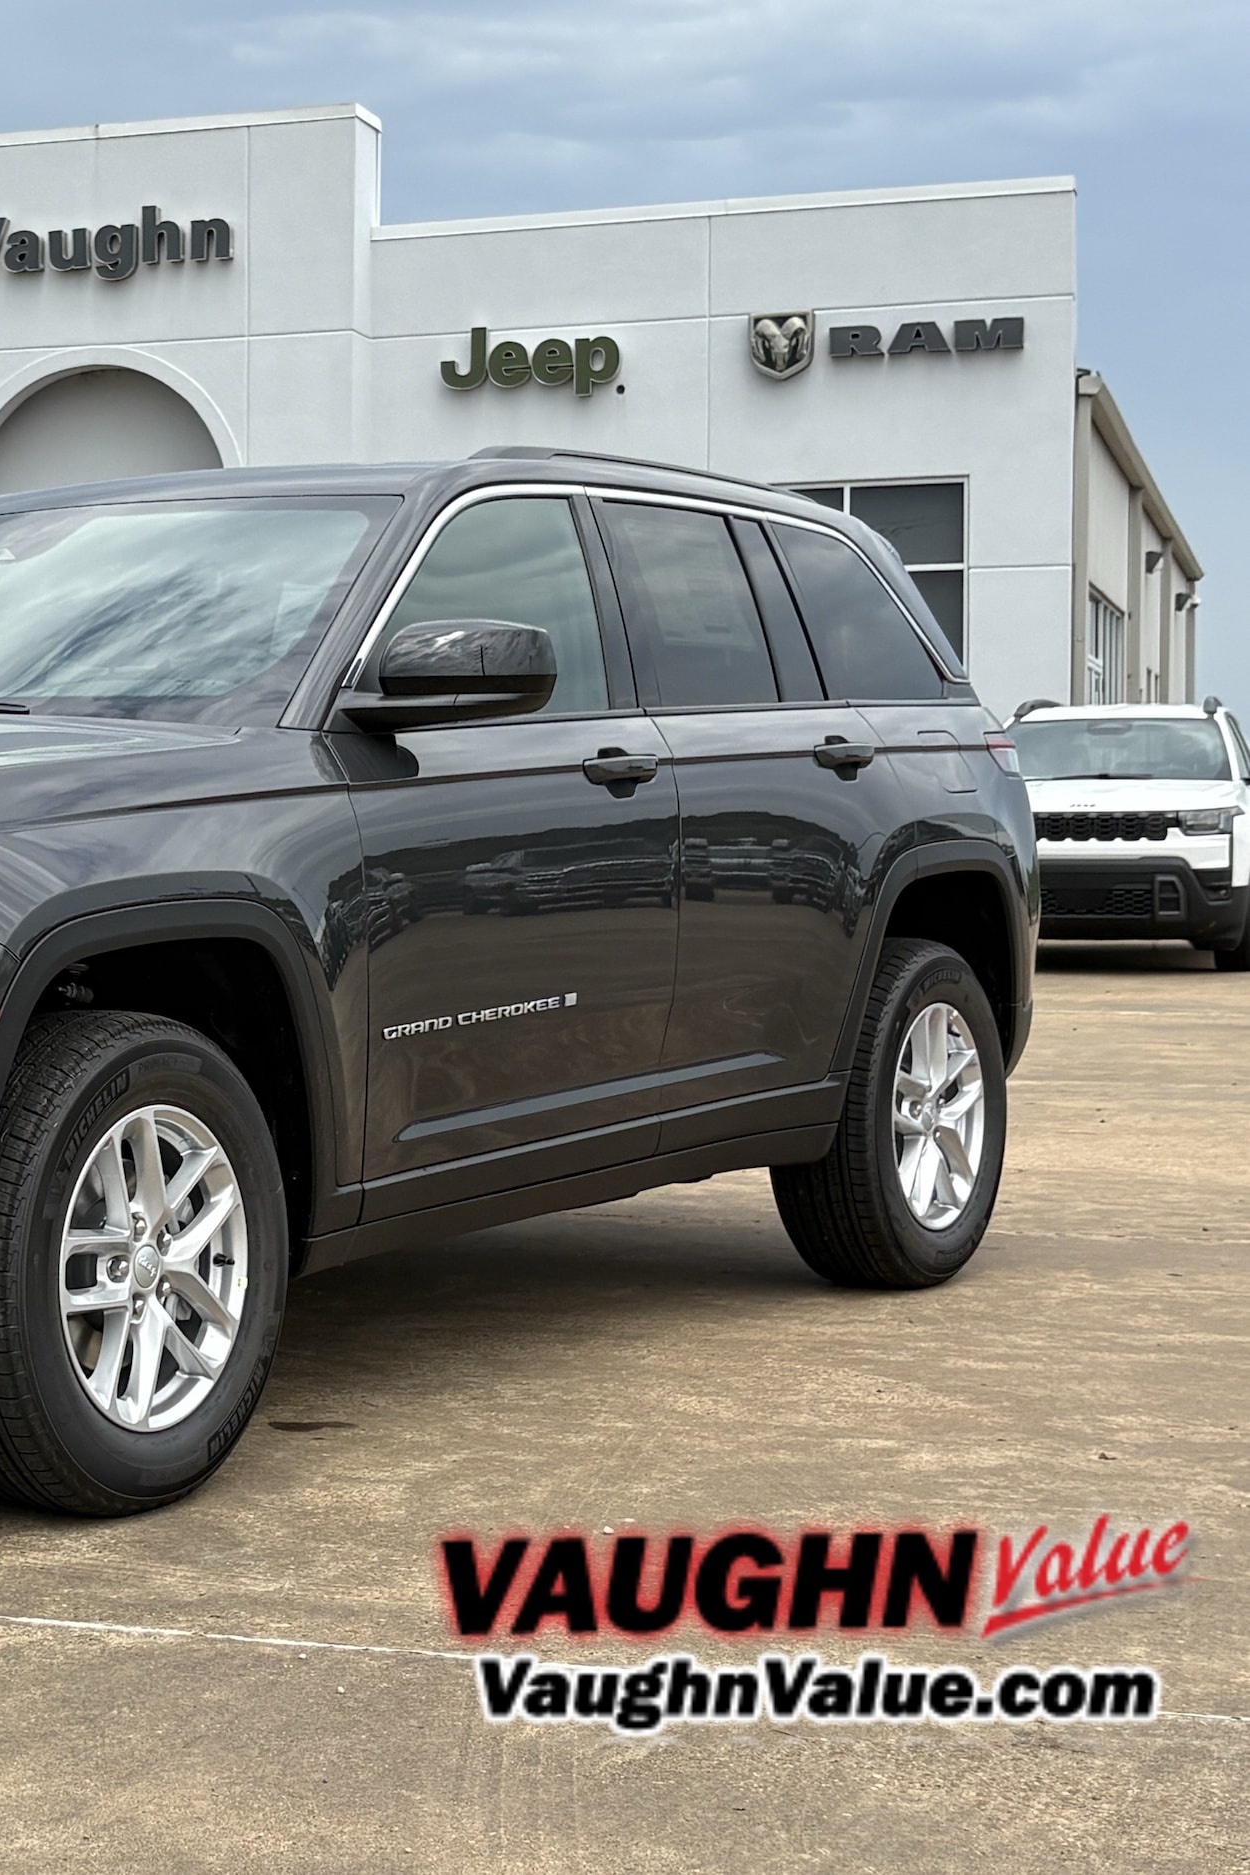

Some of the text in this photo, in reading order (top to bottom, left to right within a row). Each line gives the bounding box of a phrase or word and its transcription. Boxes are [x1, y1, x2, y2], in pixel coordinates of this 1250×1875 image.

[440, 327, 621, 397] Jeep
[829, 317, 1024, 358] RAM
[383, 996, 561, 1040] GRAND CHEROKEE
[62, 1071, 129, 1166] MICHELIN
[208, 1360, 267, 1461] MICHELIN
